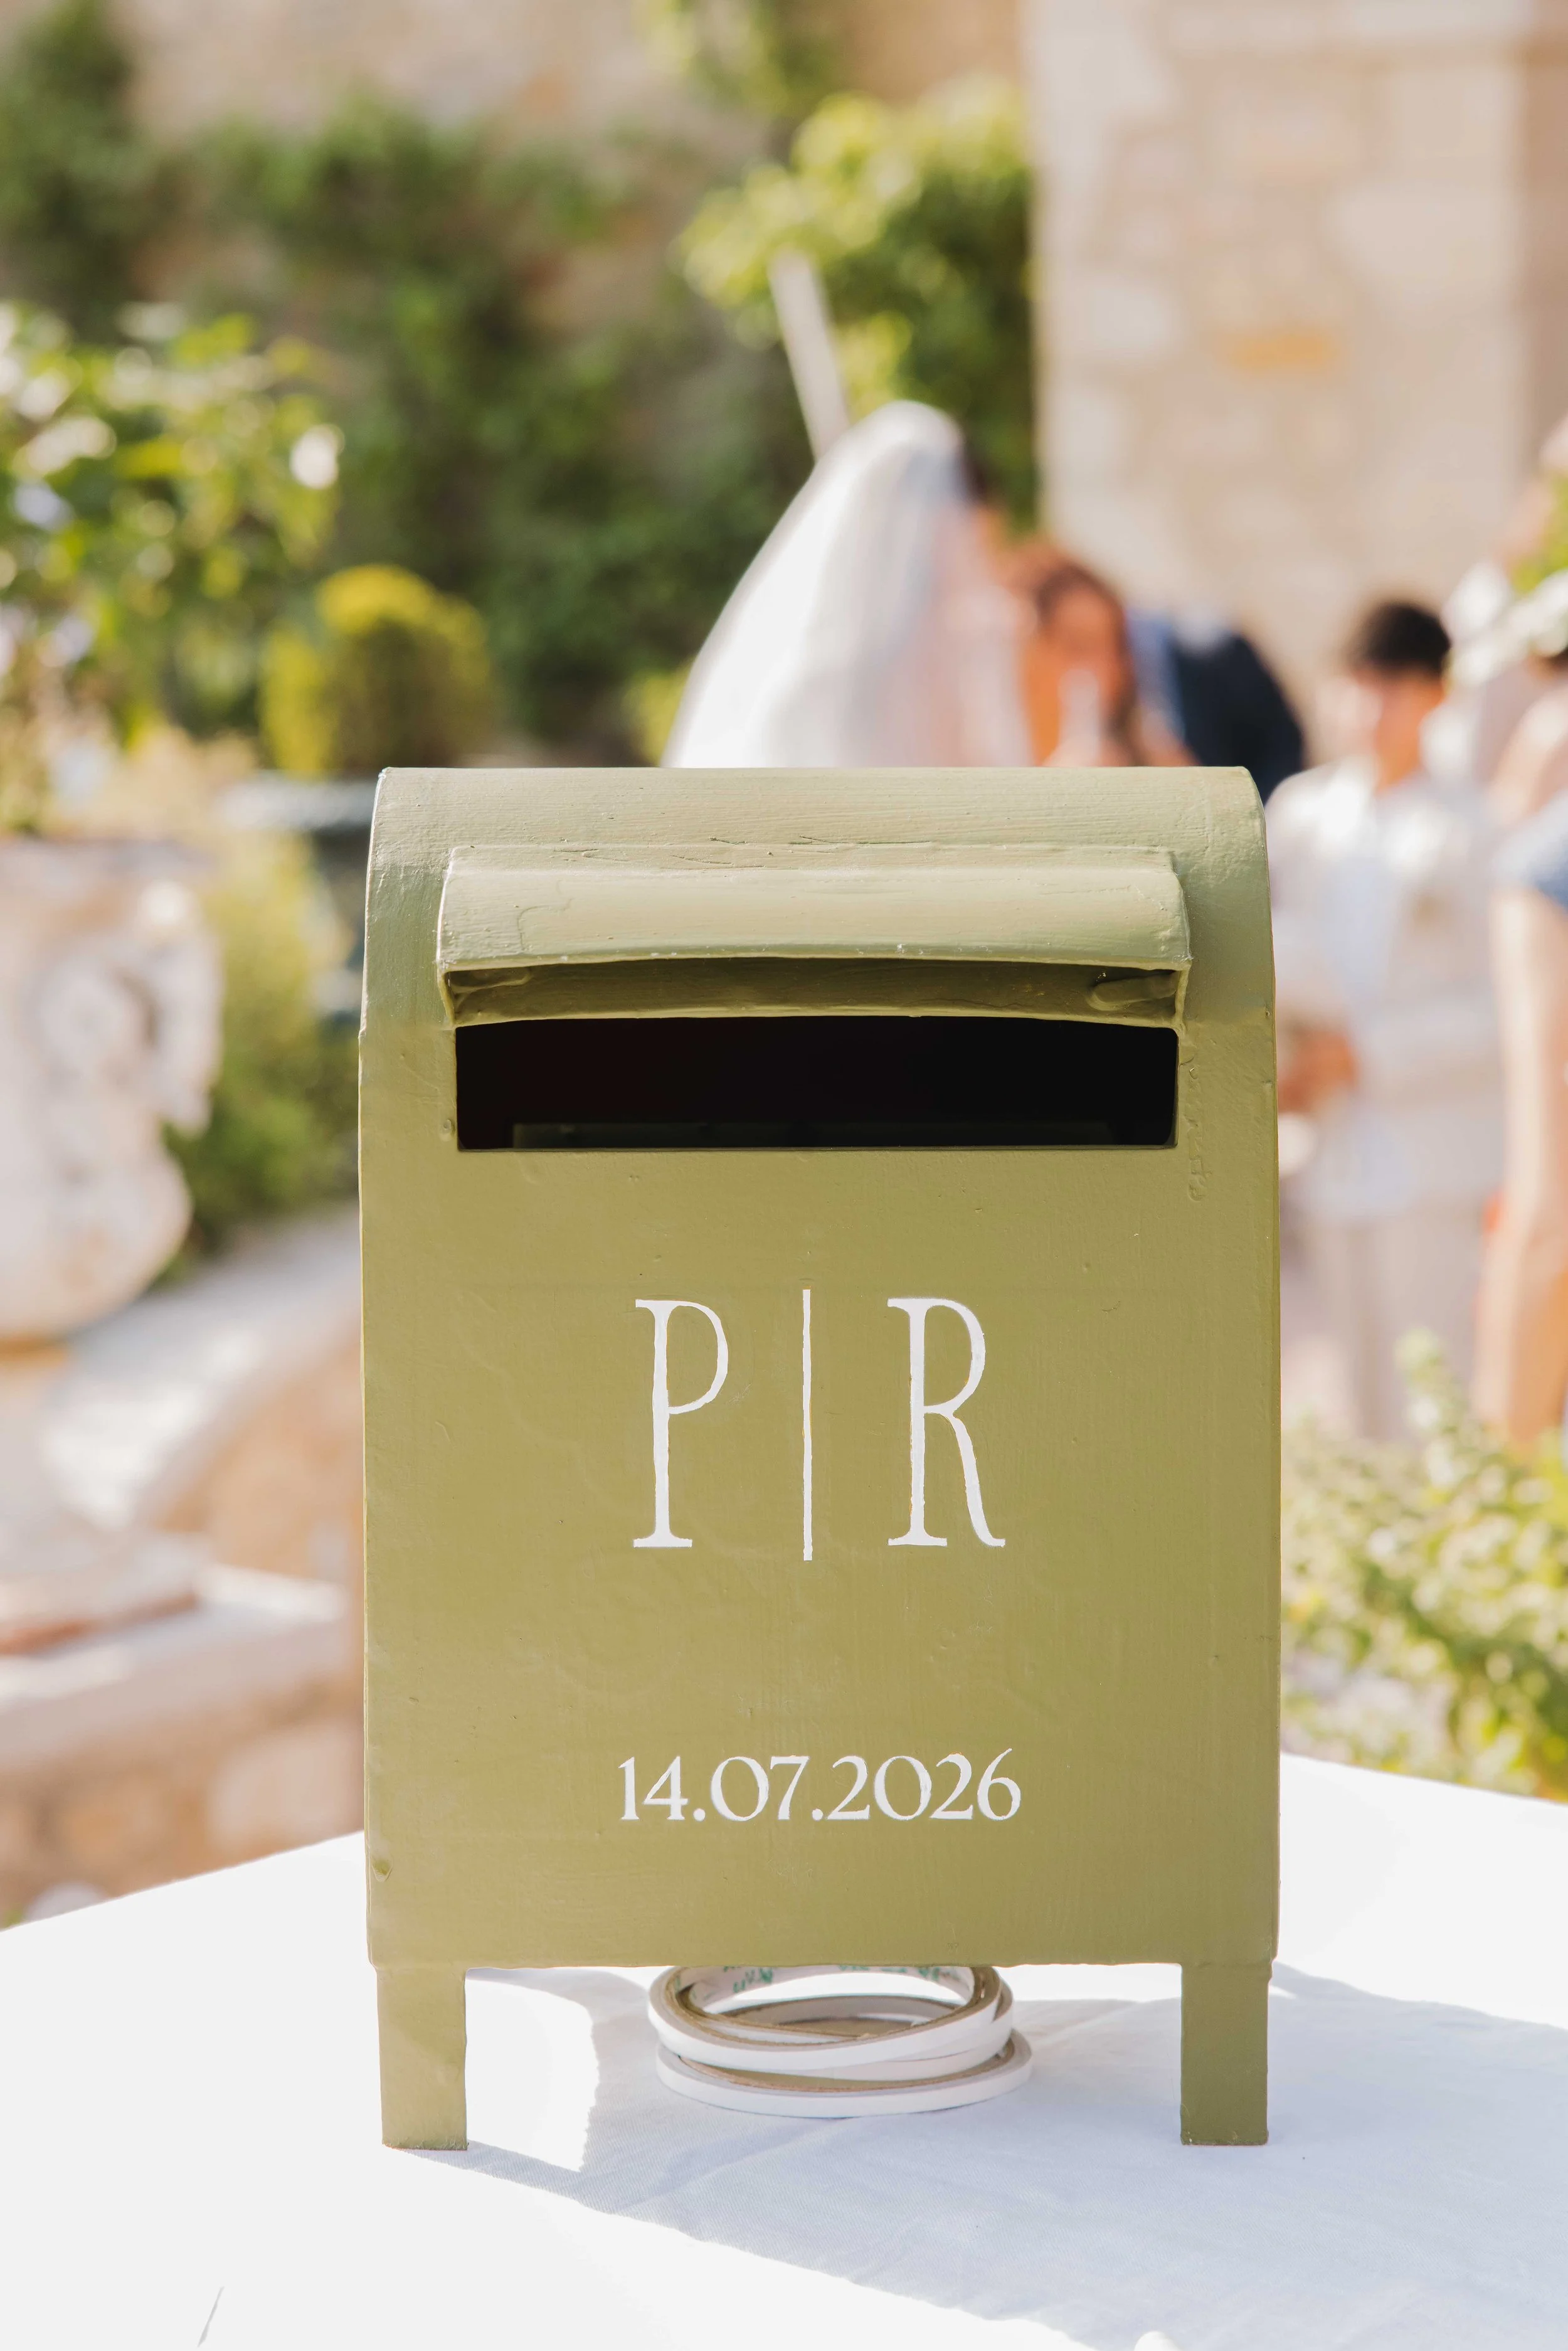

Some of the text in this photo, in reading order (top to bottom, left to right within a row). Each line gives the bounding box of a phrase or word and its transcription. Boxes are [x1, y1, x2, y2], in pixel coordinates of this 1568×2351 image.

[632, 1298, 729, 1548] P
[887, 1297, 1006, 1547] R
[618, 1748, 1022, 1822] 14.07.2026
